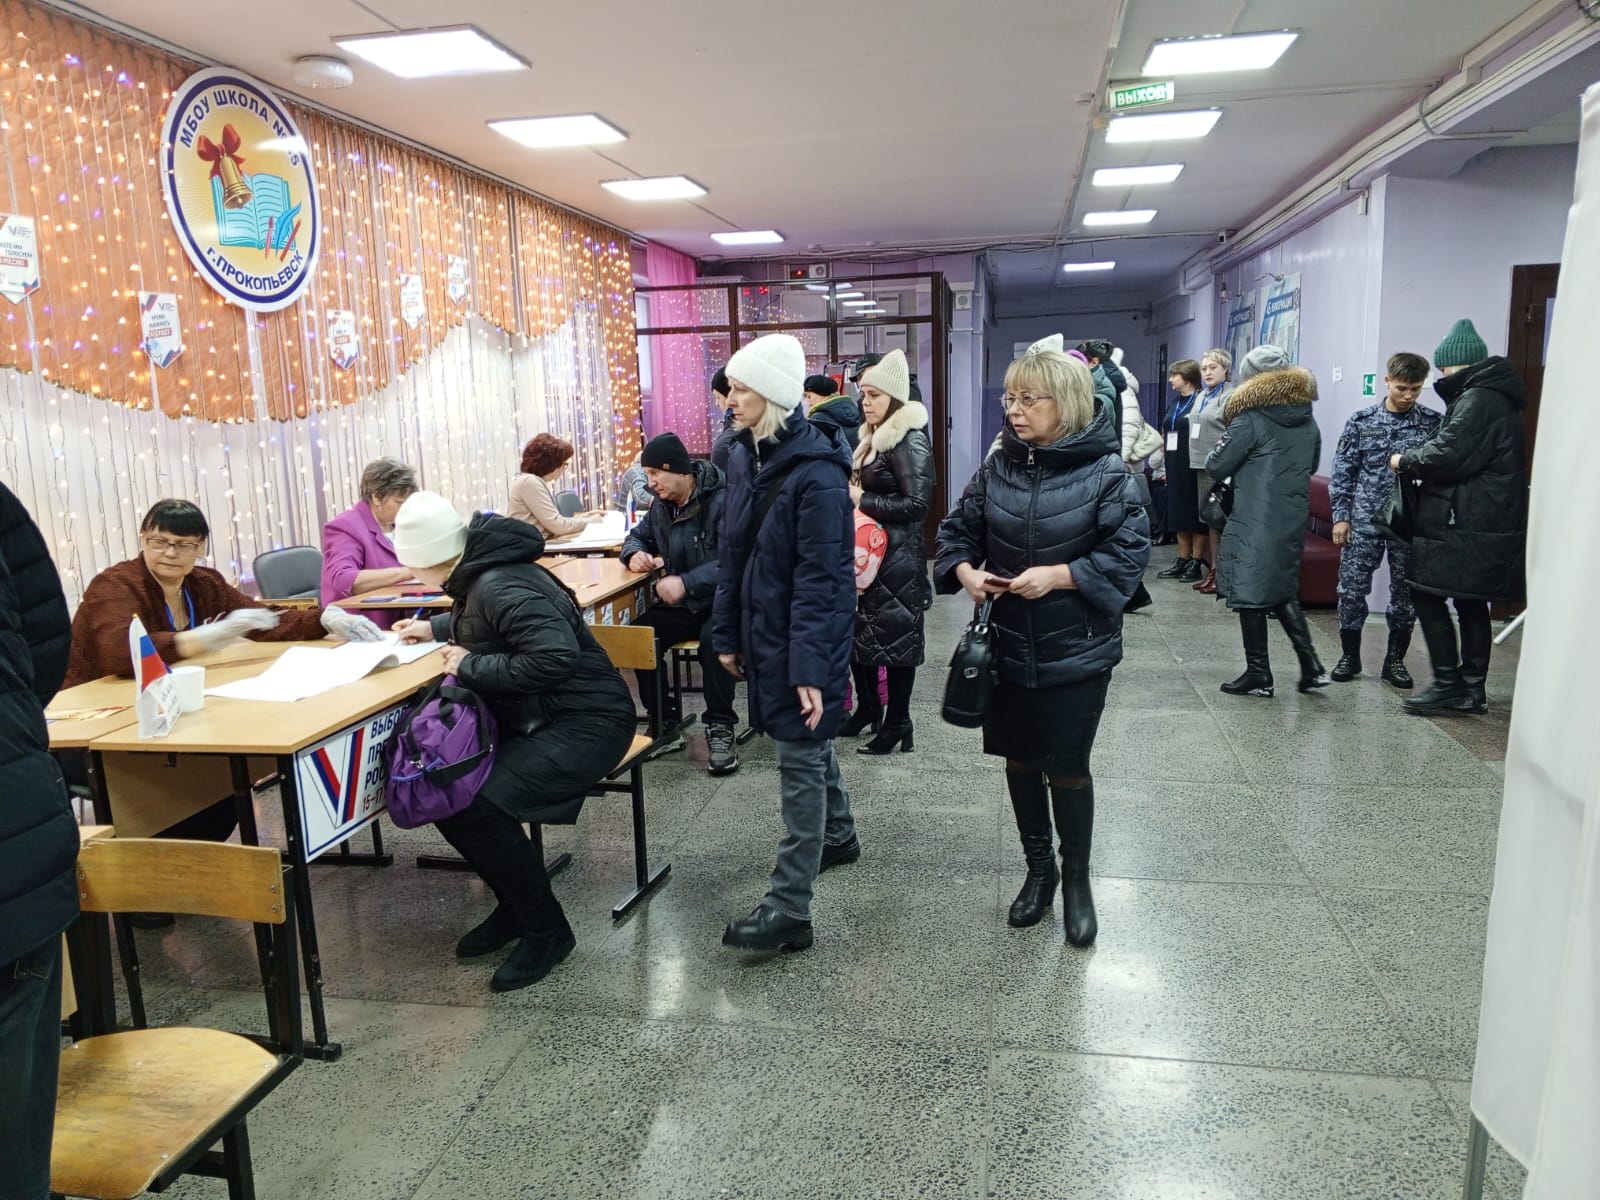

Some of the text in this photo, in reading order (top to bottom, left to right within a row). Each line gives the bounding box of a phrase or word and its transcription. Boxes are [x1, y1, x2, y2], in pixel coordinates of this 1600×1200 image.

[1117, 85, 1167, 106] ВЫХОД
[180, 96, 210, 149] МБОУ
[213, 89, 269, 123] ШКОЛА
[197, 246, 304, 291] г.ПРОКОПЬЕВСК
[364, 765, 385, 791] РОС
